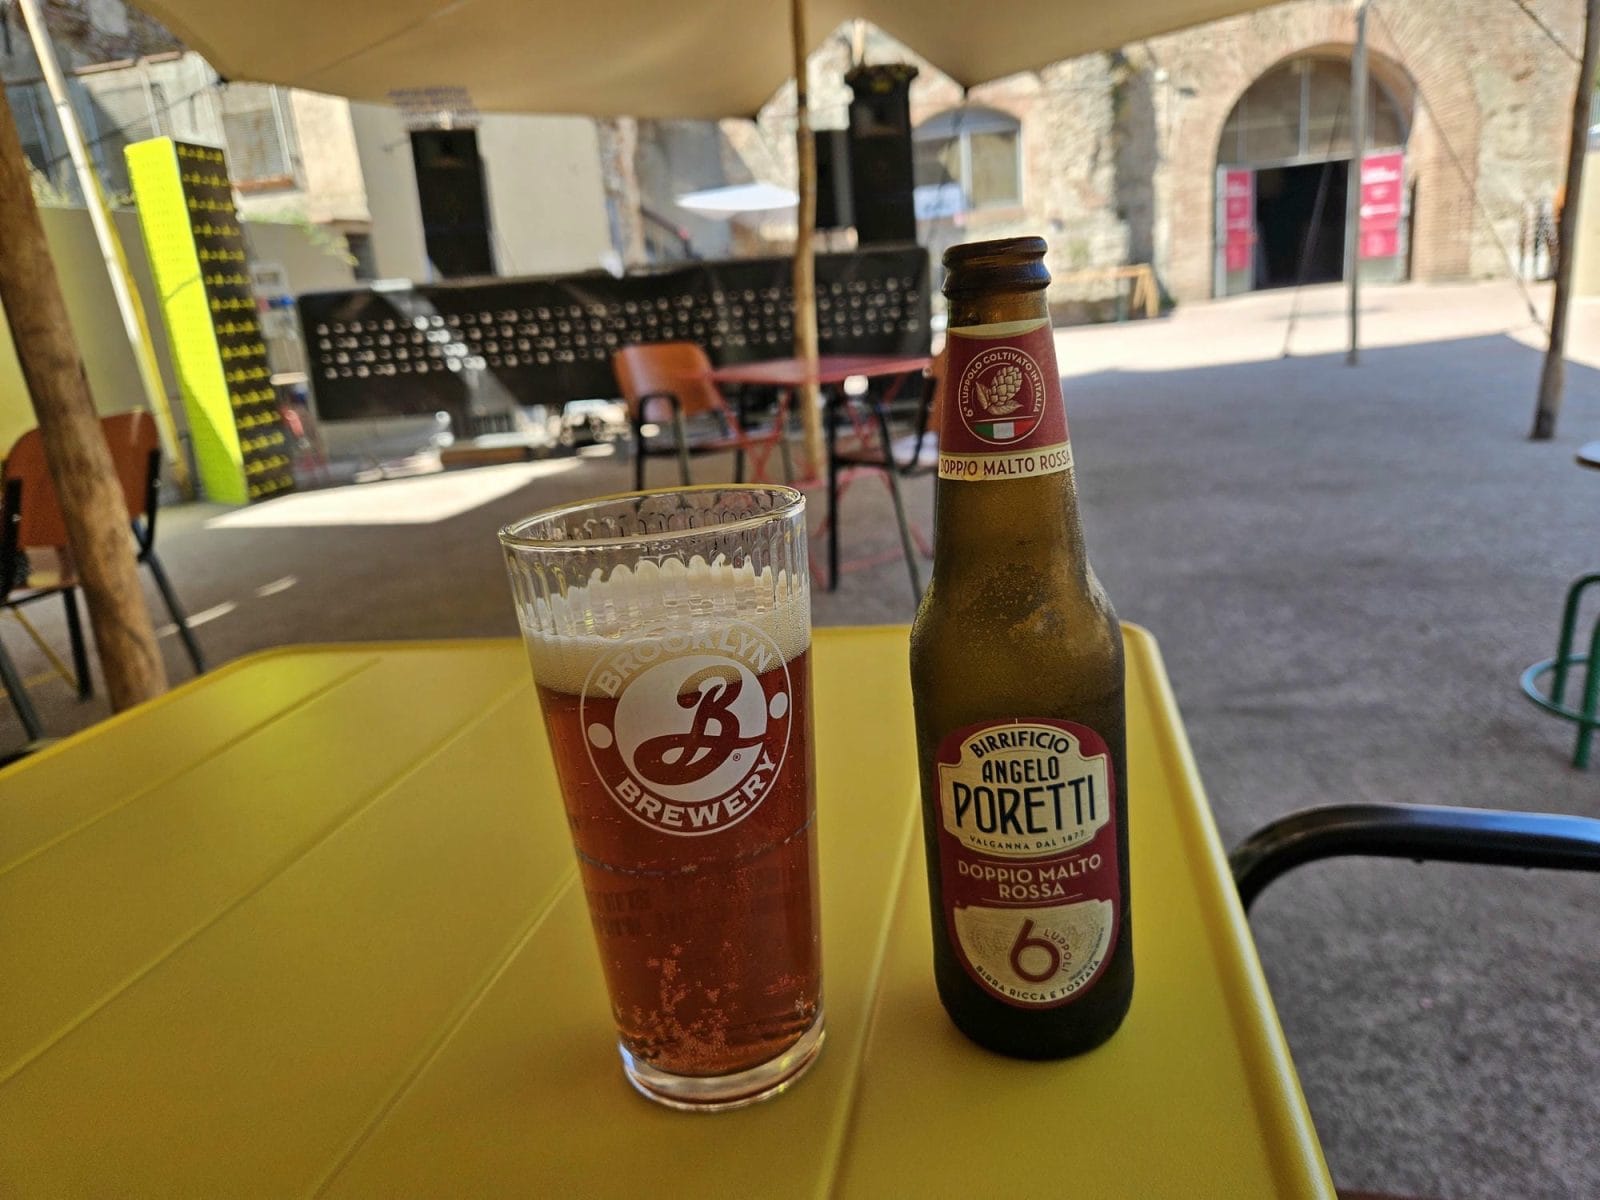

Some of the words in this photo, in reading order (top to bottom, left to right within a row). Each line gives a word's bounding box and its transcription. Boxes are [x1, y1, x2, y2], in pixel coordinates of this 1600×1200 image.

[982, 351, 1032, 371] COLTIVATO
[1030, 370, 1039, 382] IN
[962, 361, 983, 404] LUPPOLO
[1033, 382, 1042, 412] ITALIA
[984, 456, 1035, 476] MALTO
[595, 625, 773, 698] BROOKLYN
[969, 730, 1070, 758] BIRRIFICIO
[982, 756, 1060, 784] ANGELO
[615, 750, 777, 828] BREWERY
[952, 774, 1096, 836] PORETTI
[969, 834, 1030, 850] VALGANNA
[1036, 838, 1057, 850] DAL
[1062, 830, 1085, 844] 1877
[958, 859, 1033, 884] DOPPIO
[1039, 853, 1101, 881] MALTO
[998, 882, 1065, 899] ROSSA
[1010, 918, 1061, 983] 6
[1043, 928, 1072, 973] LUPPOLI
[976, 965, 1005, 992] BIRRA
[1009, 988, 1046, 1001] RICCA
[1050, 990, 1057, 999] E
[1061, 960, 1100, 995] TOSTATA
